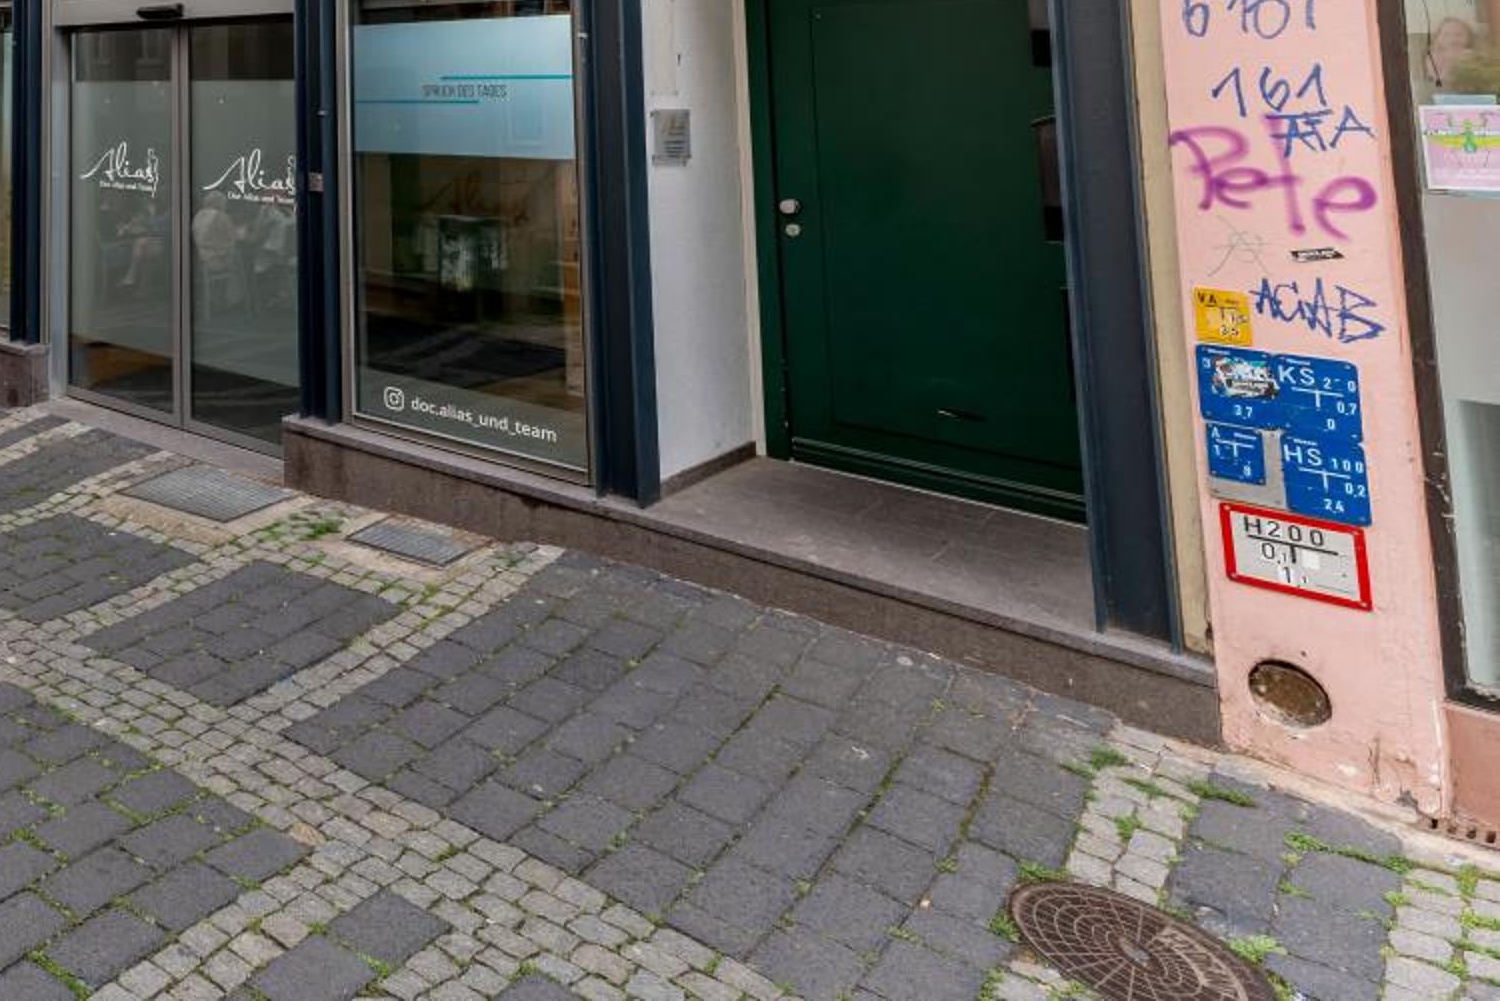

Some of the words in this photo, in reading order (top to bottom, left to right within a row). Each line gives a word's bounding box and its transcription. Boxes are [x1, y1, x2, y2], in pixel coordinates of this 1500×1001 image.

[457, 84, 476, 98] DES
[477, 84, 508, 98] TAGES
[1247, 277, 1386, 343] ACAB
[1278, 365, 1315, 386] KS
[411, 397, 557, 443] doc.alias_und_team
[1284, 444, 1323, 467] HS
[1332, 458, 1364, 473] 100
